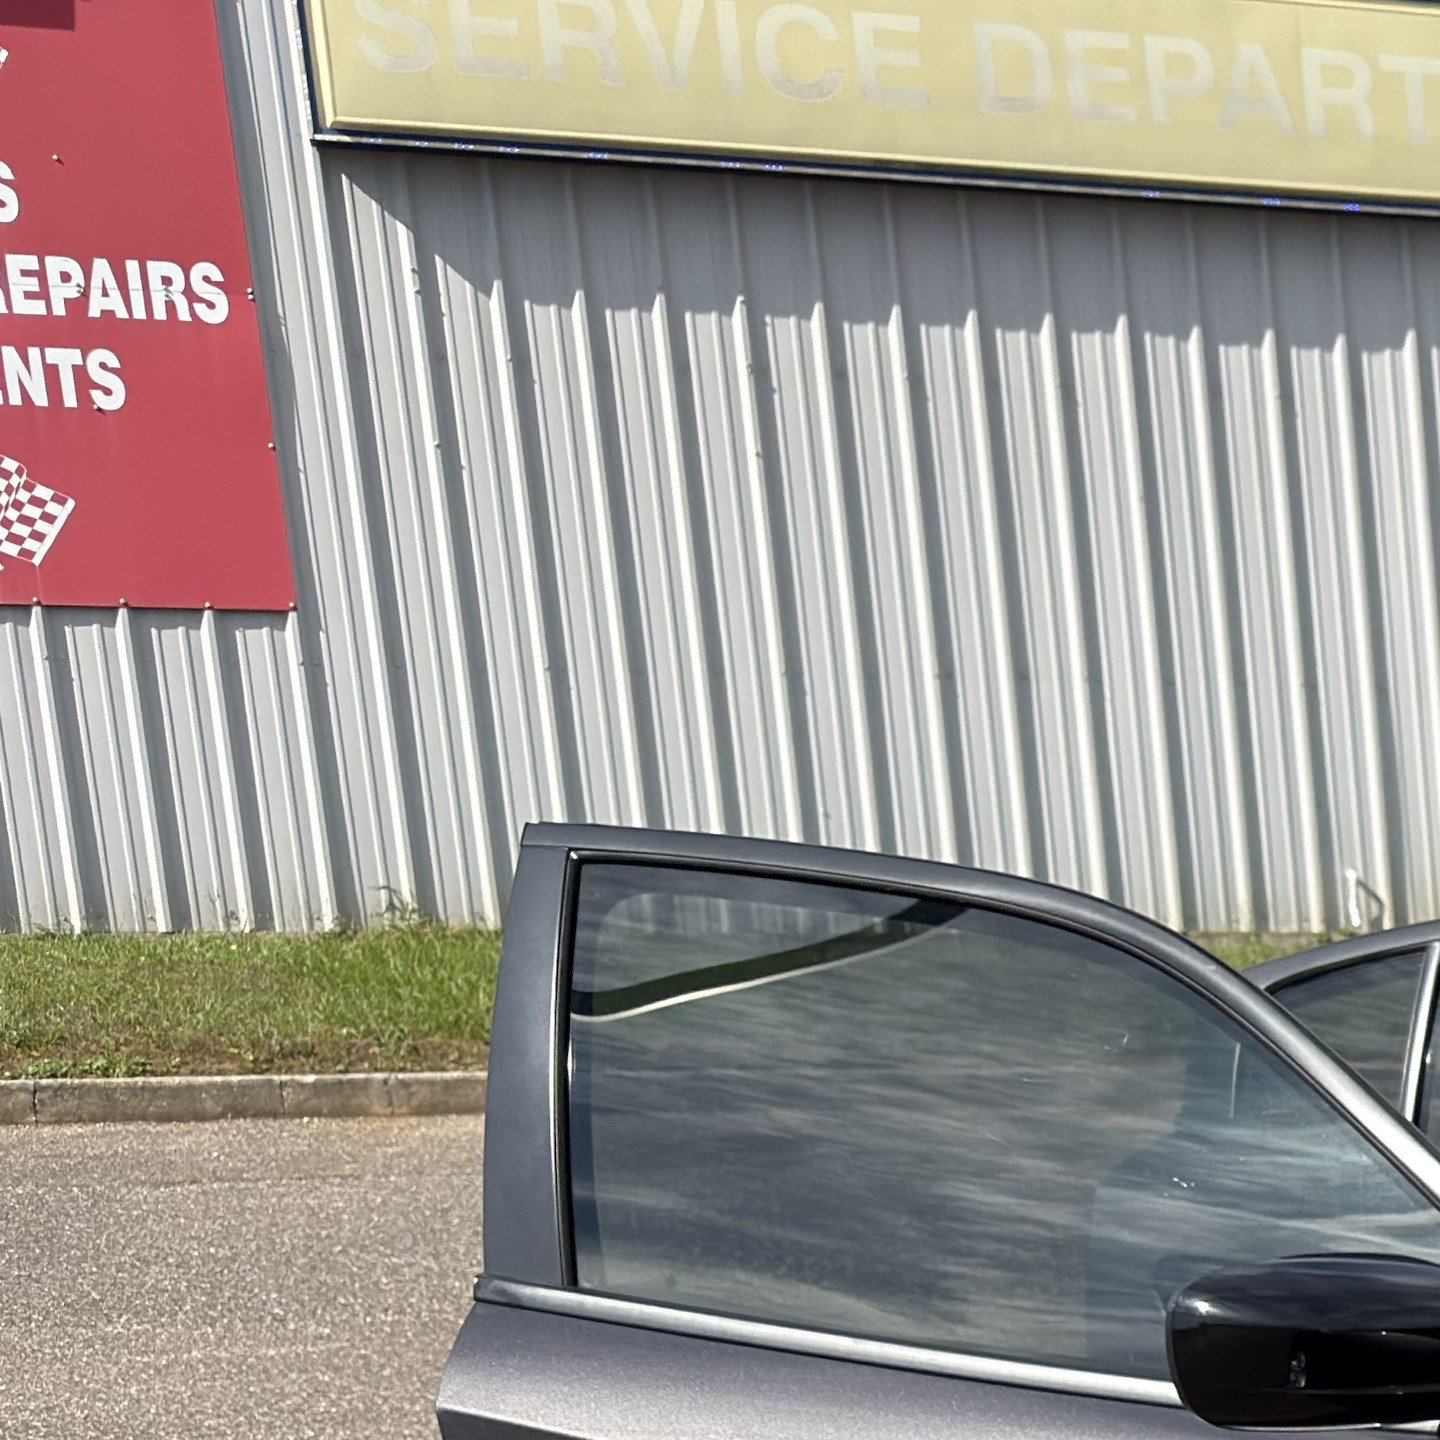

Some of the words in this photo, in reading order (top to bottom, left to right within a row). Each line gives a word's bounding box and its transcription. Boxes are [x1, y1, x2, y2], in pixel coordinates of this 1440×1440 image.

[355, 0, 932, 111] SERVICE
[0, 253, 230, 325] EPAIRS
[0, 345, 127, 412] NTS
